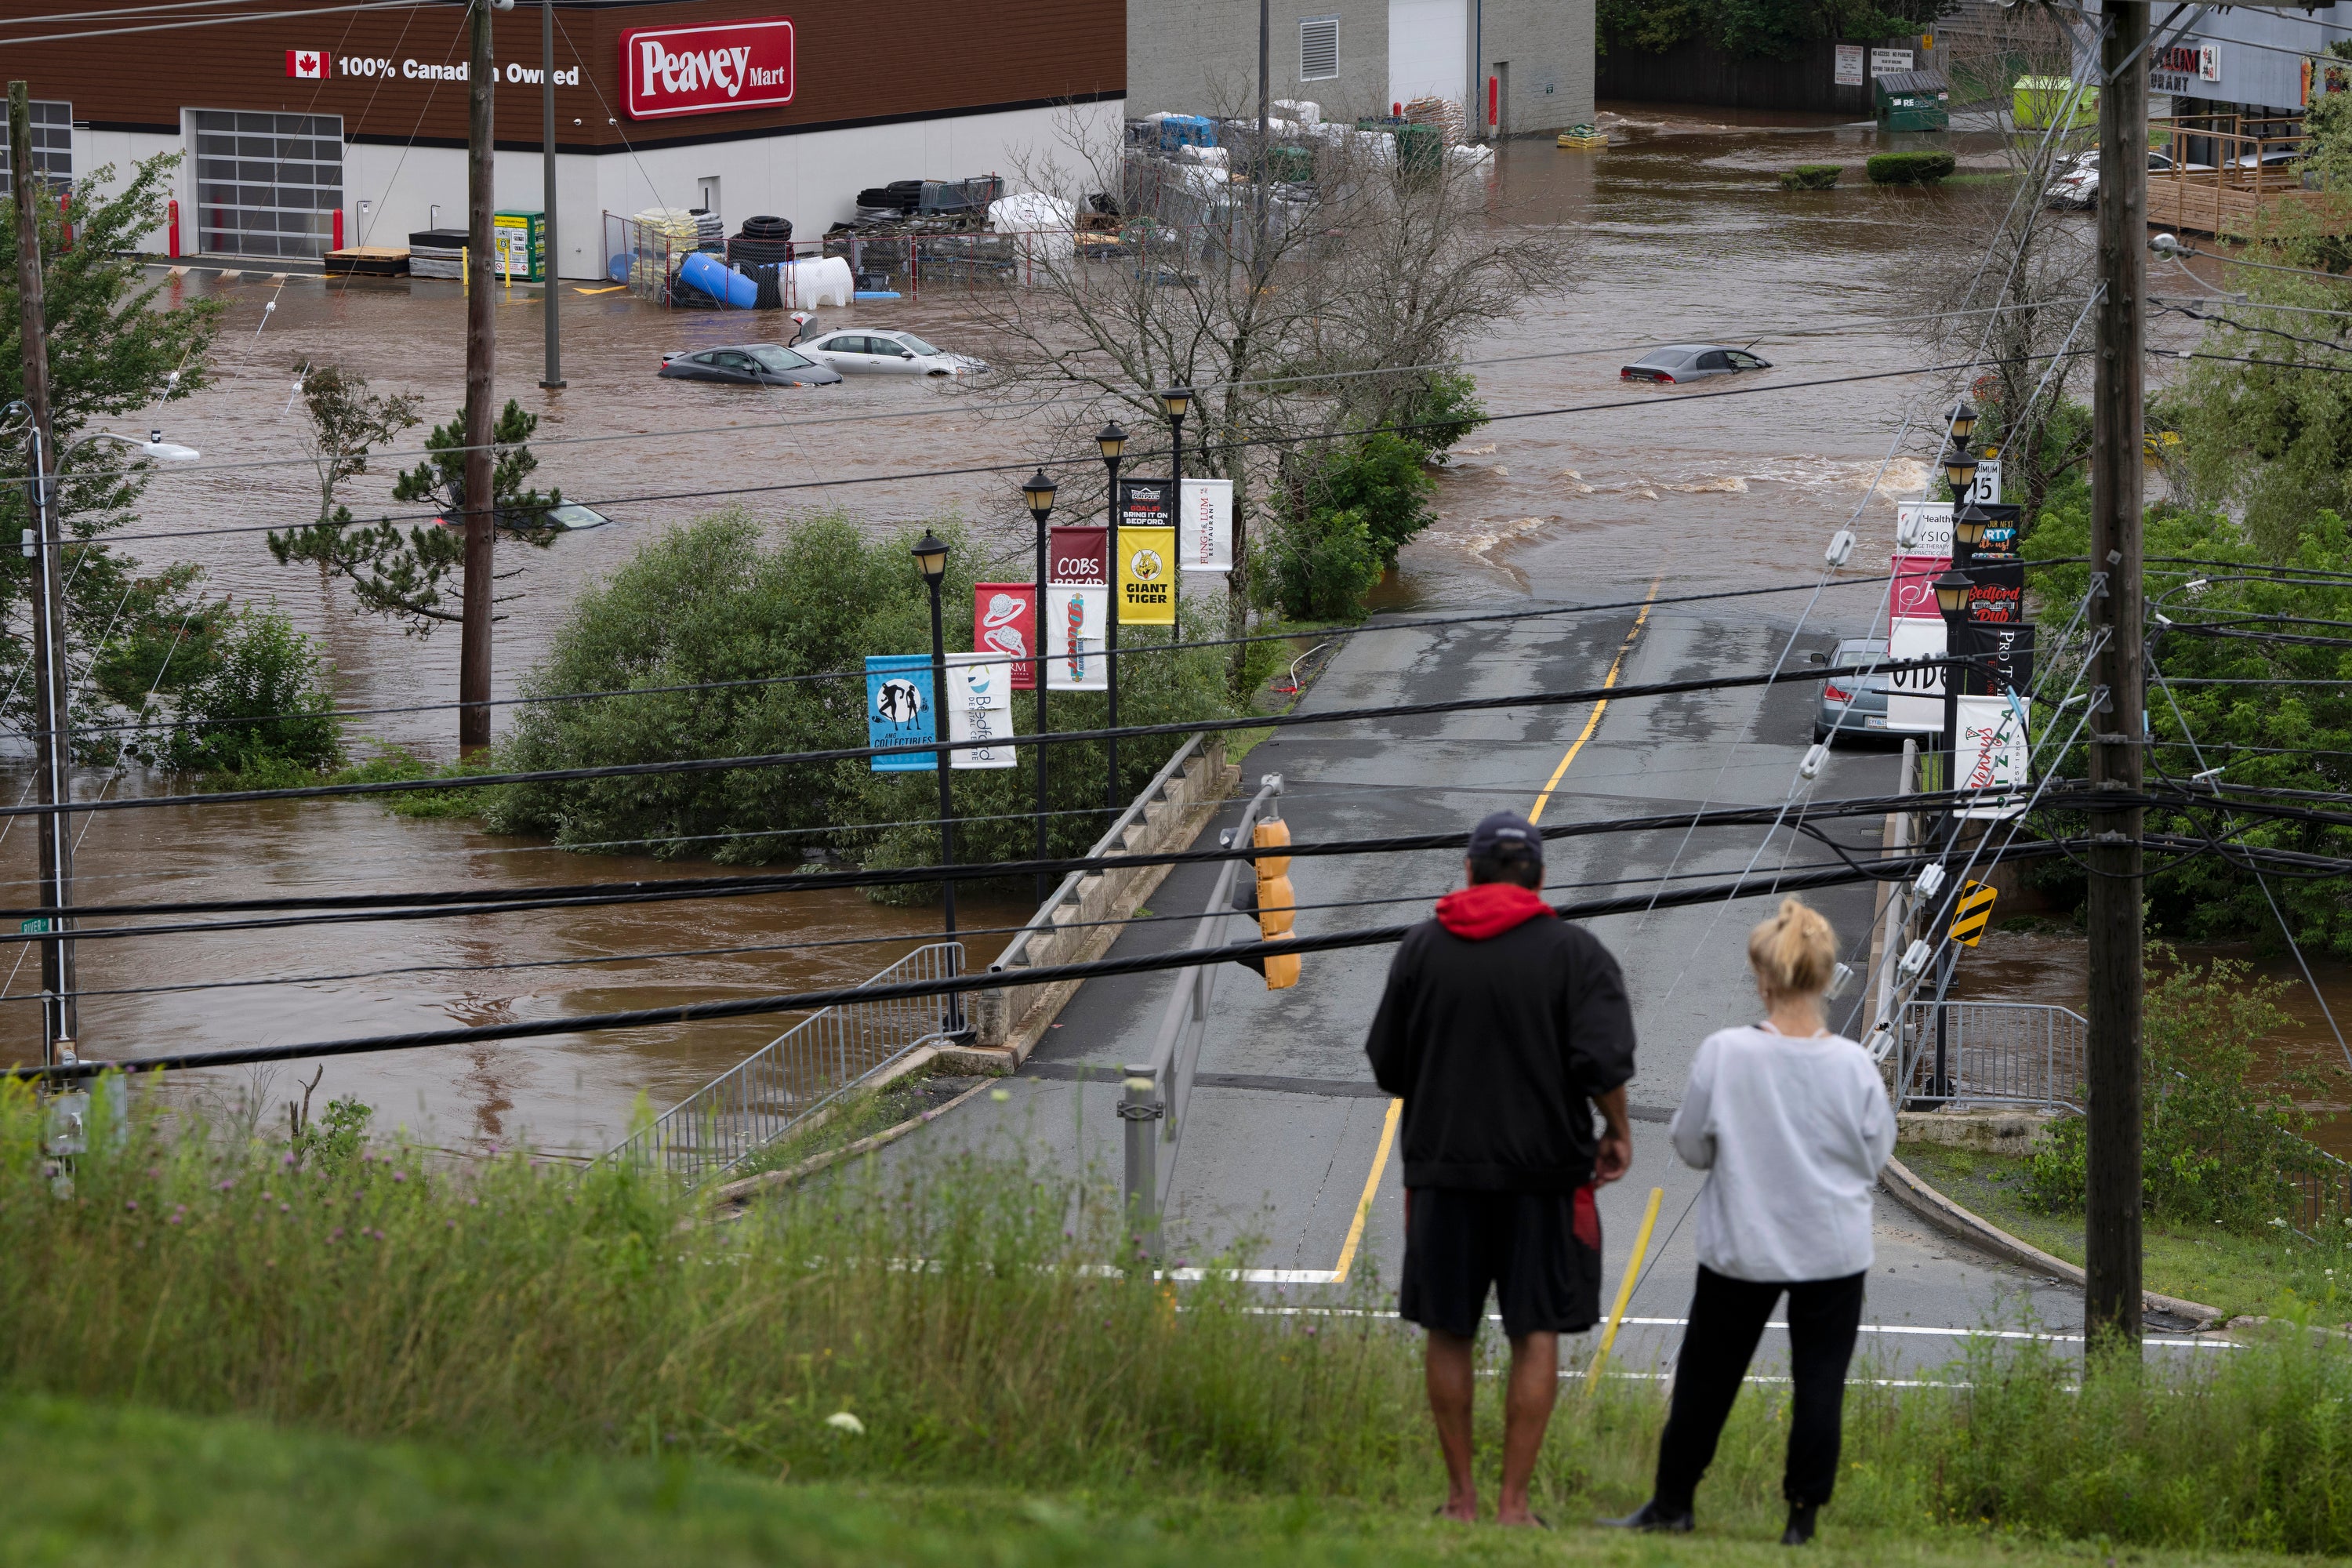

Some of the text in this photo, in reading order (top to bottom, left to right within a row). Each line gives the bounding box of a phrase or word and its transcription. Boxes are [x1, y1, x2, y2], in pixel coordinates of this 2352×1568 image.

[339, 56, 396, 79] 100%
[640, 41, 751, 97] Peavey
[750, 66, 785, 87] Mart
[1976, 464, 1998, 474] XIMUM
[1973, 477, 1992, 500] 15
[1200, 498, 1209, 521] LUM
[1920, 532, 1950, 543] YSIO
[1983, 529, 2011, 539] ARTY
[1200, 536, 1209, 564] FUNG
[1058, 557, 1099, 575] COBS
[1127, 583, 1167, 593] GIANT
[1969, 586, 2020, 603] Bedford
[1127, 594, 1167, 604] TIGER
[1976, 608, 2009, 622] Pub
[874, 735, 933, 747] COLLECTIBLES
[1995, 708, 2014, 809] PIZZA
[24, 920, 42, 934] RIVER
